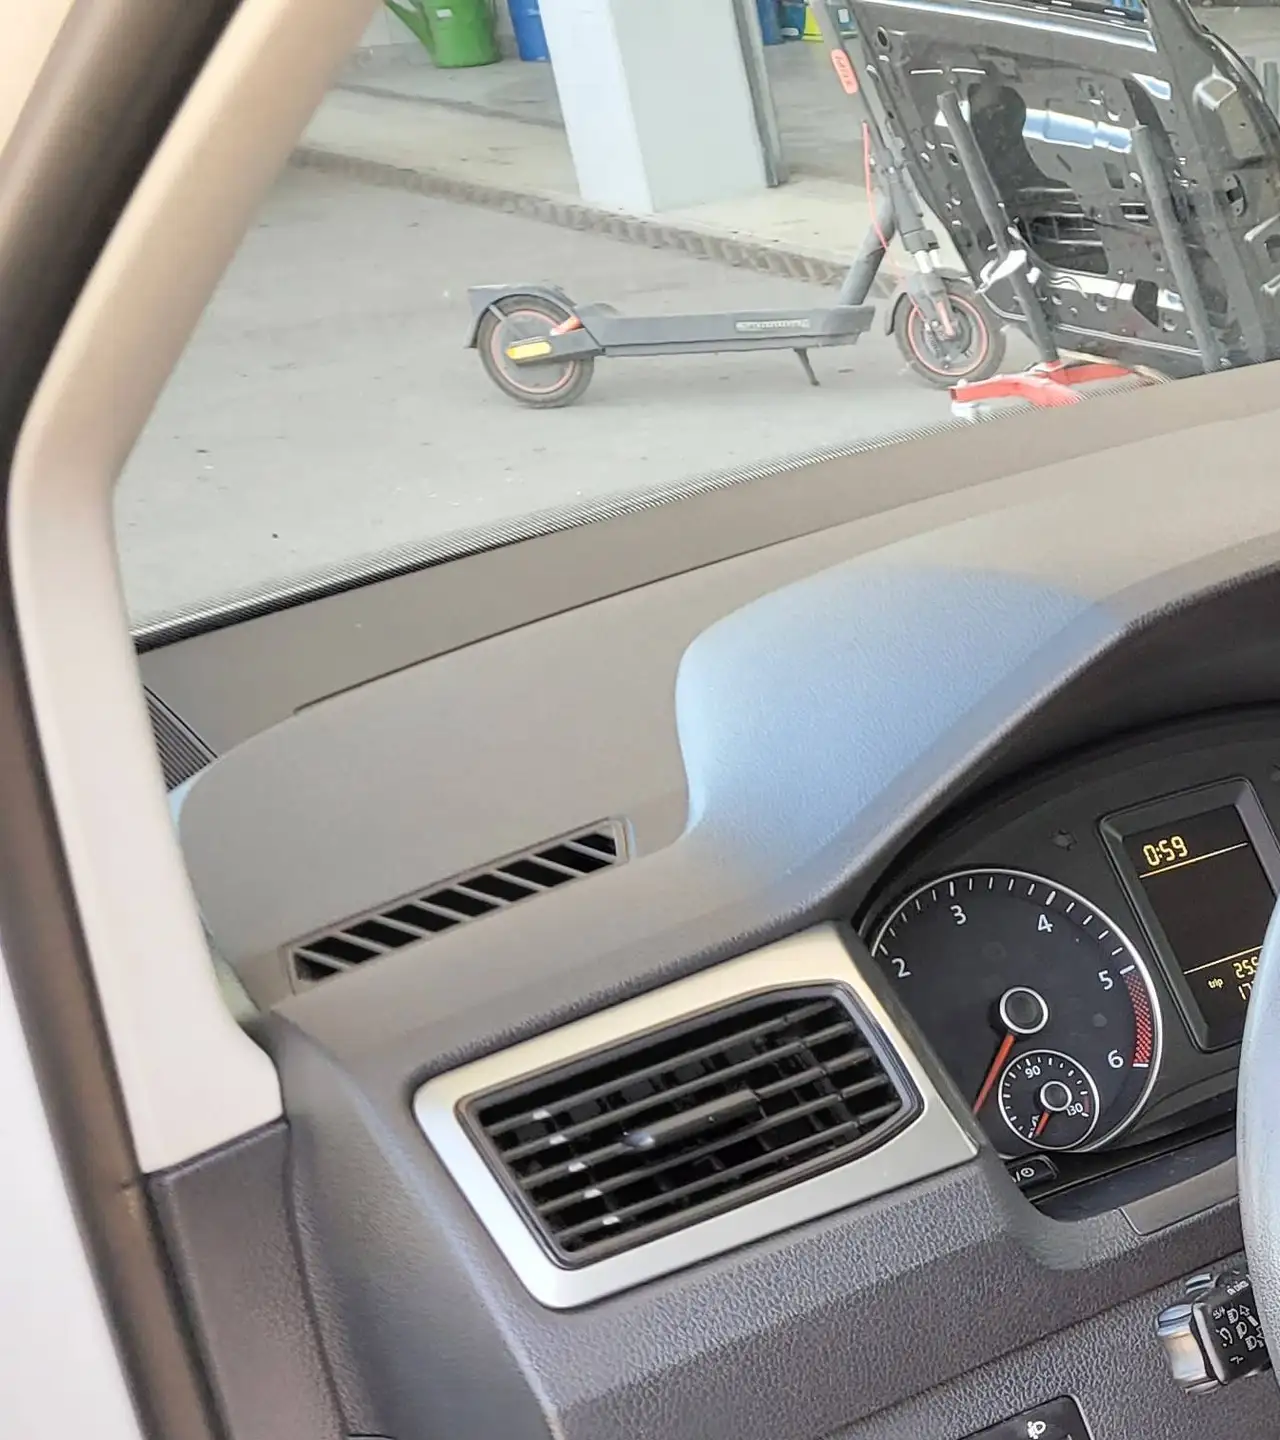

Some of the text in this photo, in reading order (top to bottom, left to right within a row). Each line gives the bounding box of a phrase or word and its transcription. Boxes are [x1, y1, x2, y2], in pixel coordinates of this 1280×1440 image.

[1143, 835, 1188, 866] 0:59
[950, 905, 967, 925] 3
[1037, 914, 1053, 933] 4
[891, 958, 911, 978] 2
[1098, 970, 1113, 990] 5
[1107, 1050, 1124, 1069] 6
[1025, 1065, 1041, 1078] 90
